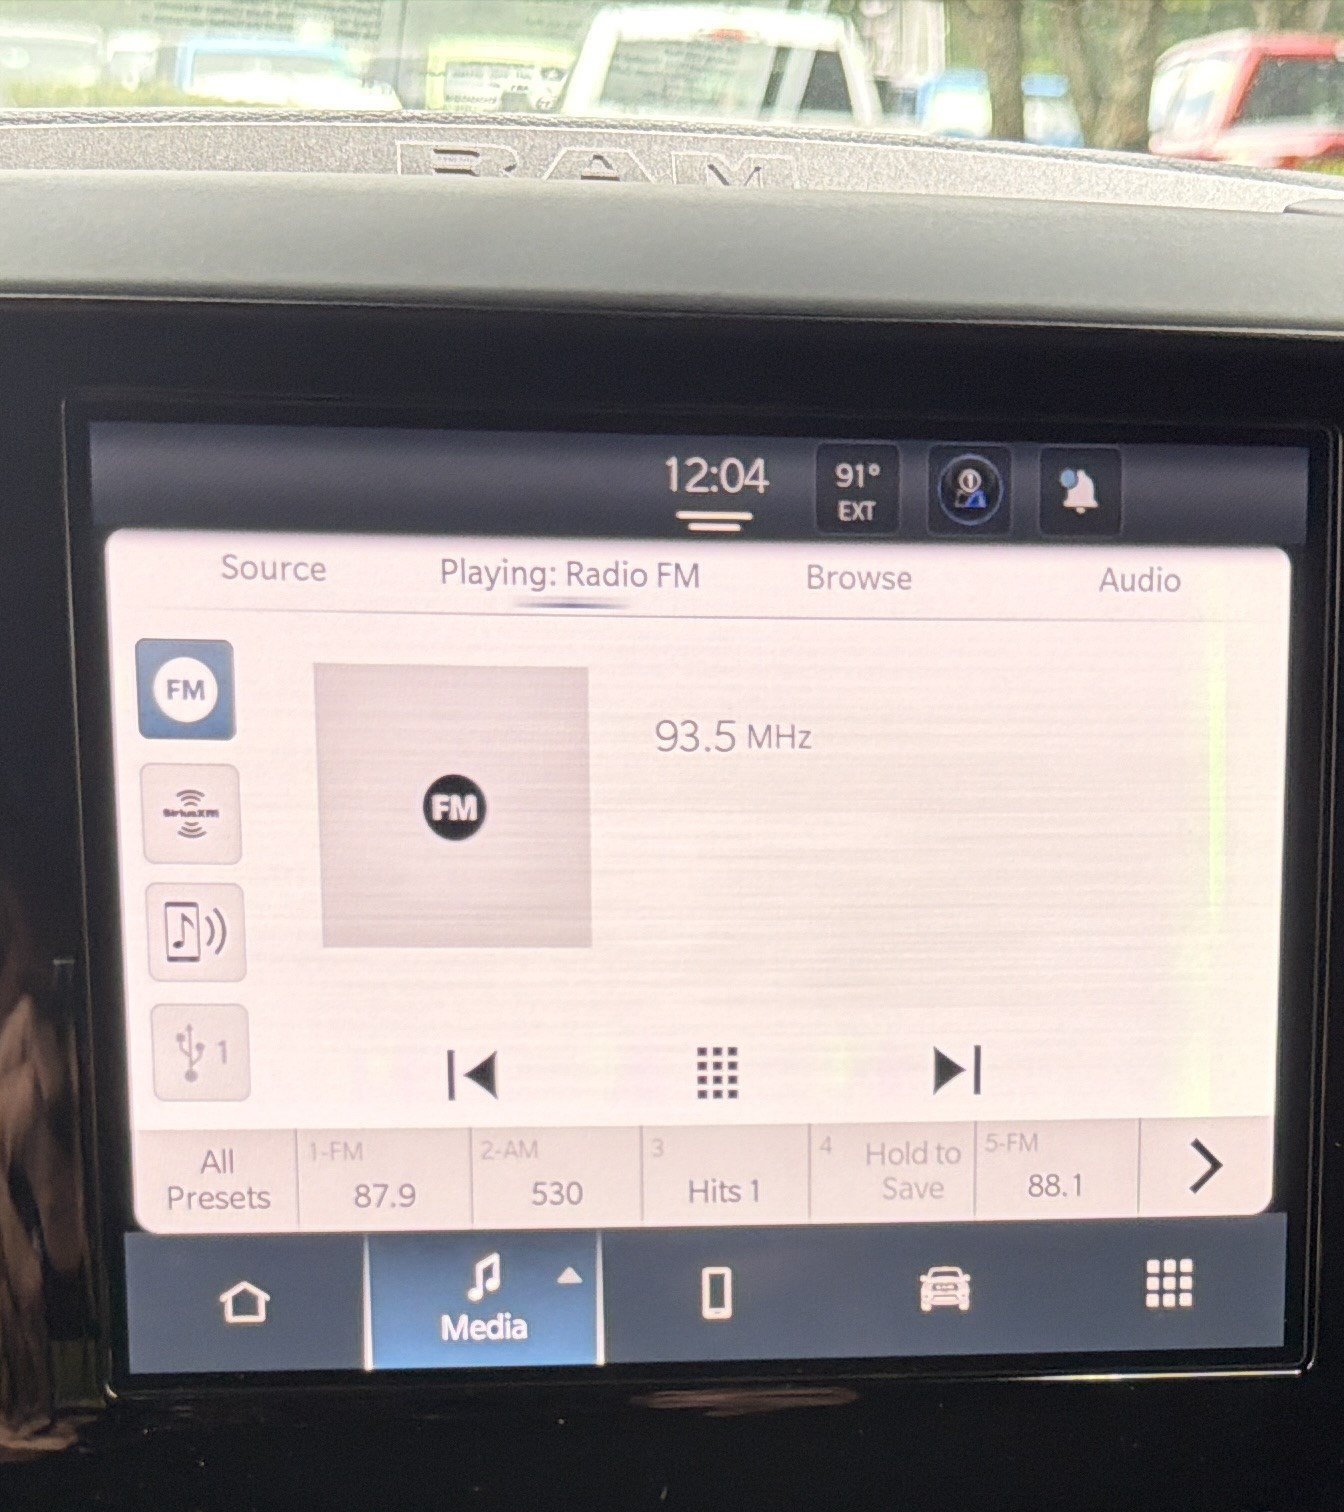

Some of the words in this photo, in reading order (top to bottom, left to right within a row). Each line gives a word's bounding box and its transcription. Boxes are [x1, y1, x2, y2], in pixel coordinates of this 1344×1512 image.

[395, 139, 800, 188] RAM
[664, 456, 770, 494] 12:04
[834, 463, 880, 489] 91°
[838, 500, 876, 522] EXT
[221, 554, 327, 581] Source
[440, 558, 556, 591] Playing:
[566, 561, 648, 588] Radio
[657, 562, 700, 588] FM
[806, 564, 912, 590] Browse
[1099, 567, 1181, 593] Audio
[166, 679, 205, 701] FM
[655, 719, 736, 752] 93.5
[747, 723, 812, 749] MHz
[431, 794, 479, 822] FM
[216, 1039, 228, 1064] 1
[310, 1141, 363, 1161] 1-FM
[481, 1140, 539, 1160] 2-AM
[652, 1138, 664, 1158] 3
[819, 1136, 832, 1154] 4
[866, 1141, 929, 1166] Hold
[935, 1144, 961, 1165] to
[984, 1133, 1038, 1153] 5-FM
[200, 1149, 233, 1174] All
[167, 1185, 271, 1211] Presets
[354, 1183, 416, 1208] 87.9
[531, 1181, 584, 1206] 530
[688, 1179, 742, 1203] Hits
[749, 1179, 760, 1202] 1
[882, 1177, 944, 1200] Save
[1027, 1173, 1083, 1198] 88.1
[441, 1313, 528, 1341] Media
